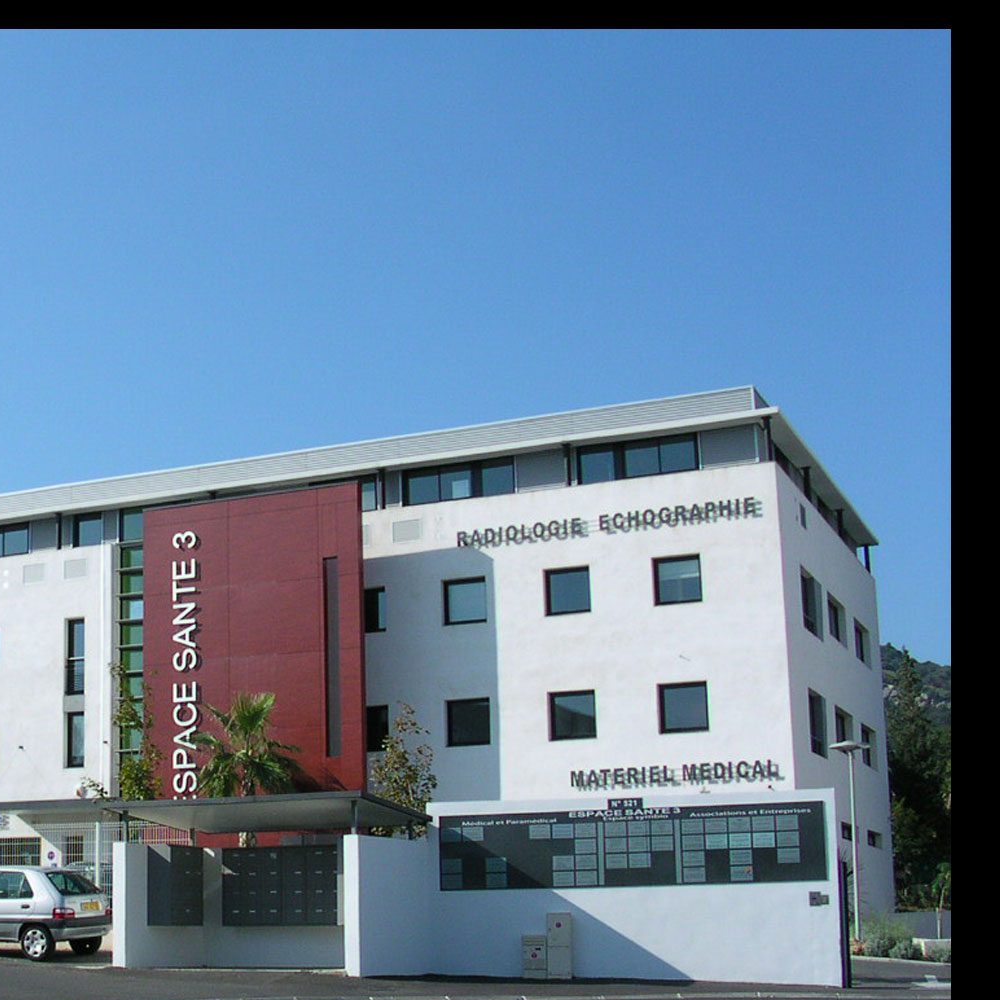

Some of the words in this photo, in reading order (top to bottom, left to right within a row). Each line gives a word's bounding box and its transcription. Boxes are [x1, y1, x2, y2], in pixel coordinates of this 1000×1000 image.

[456, 517, 582, 548] RADIOLOGIE
[598, 497, 755, 531] ECHOGRAPHIE
[172, 530, 197, 549] 3
[172, 558, 198, 672] SANTE
[570, 765, 673, 788] MATERIEL
[682, 759, 777, 781] MEDICAL
[568, 809, 622, 819] ESPACE
[624, 807, 671, 816] SANTE
[759, 807, 812, 815] Entreprises
